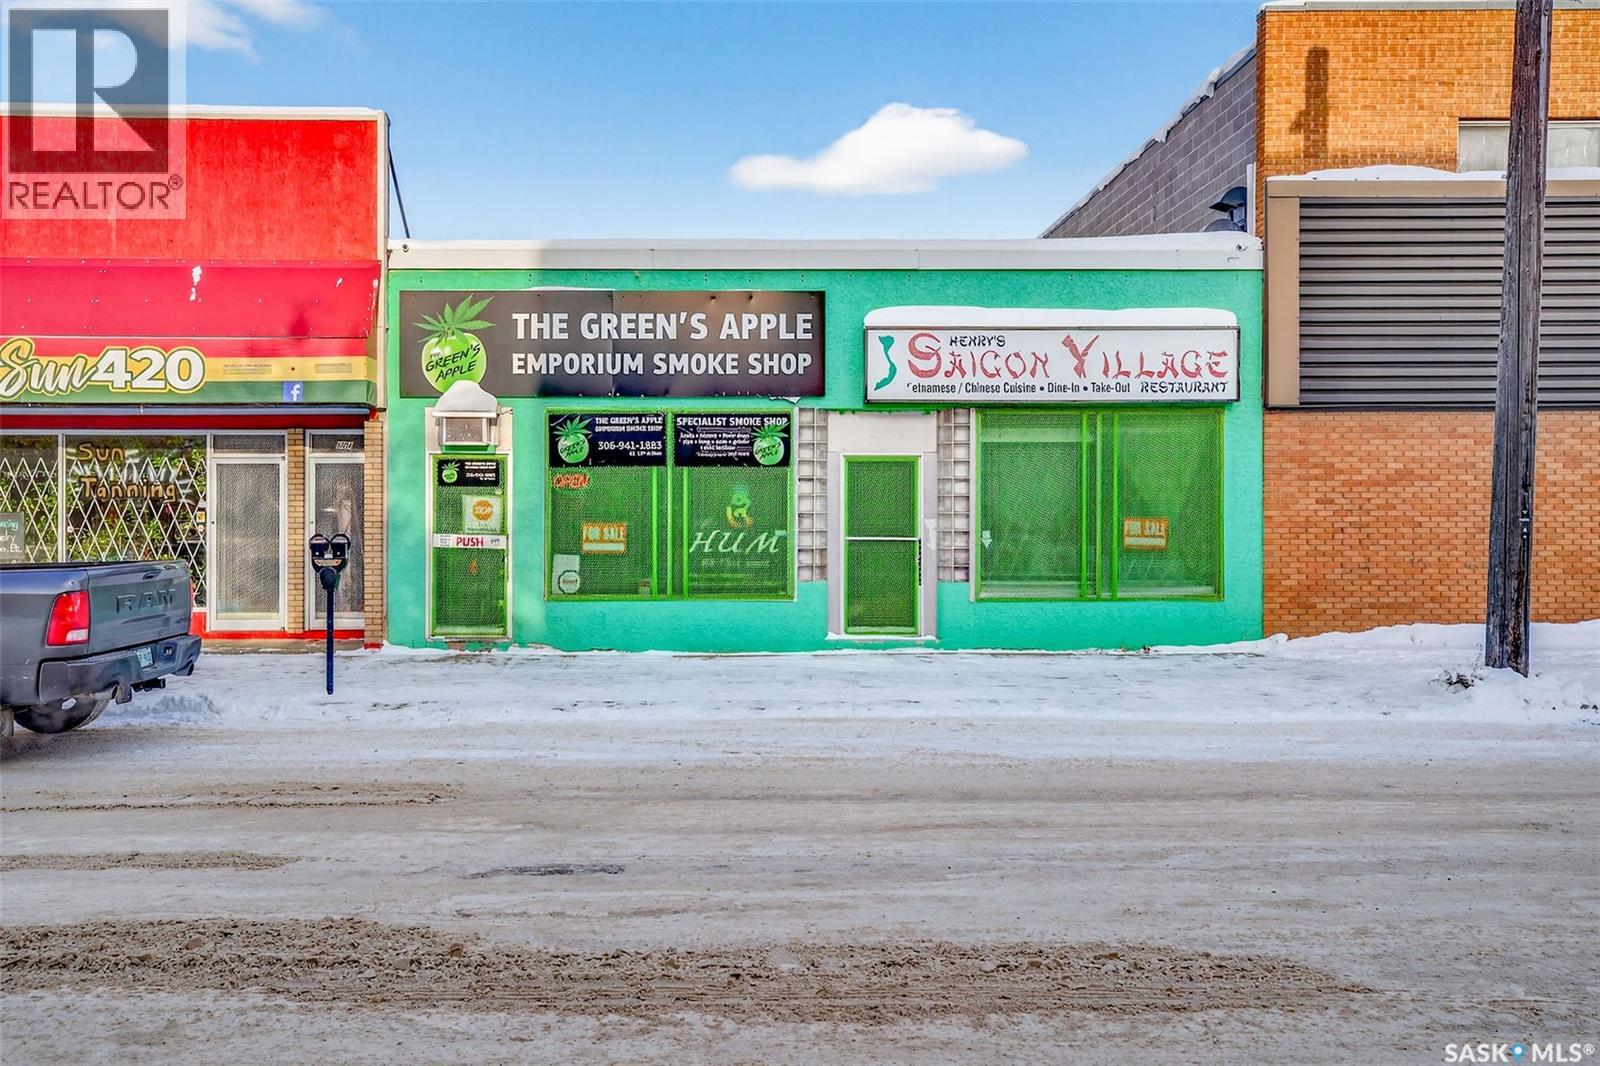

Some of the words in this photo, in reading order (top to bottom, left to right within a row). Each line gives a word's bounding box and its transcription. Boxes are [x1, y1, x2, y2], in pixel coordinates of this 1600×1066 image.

[511, 312, 569, 340] THE
[579, 312, 709, 341] GREEN'S
[719, 312, 813, 341] APPLE
[949, 334, 1006, 348] HENRY'S
[425, 343, 481, 373] GREEN'S
[511, 352, 645, 376] EMPORIUM
[653, 353, 740, 376] SMOKE
[747, 353, 813, 376] SHOP
[906, 332, 1049, 380] SAIGON
[1060, 333, 1230, 380] VILLAGE
[435, 359, 478, 384] APPLE
[964, 382, 1001, 394] Chinese
[1003, 382, 1037, 394] Cuisine
[1047, 382, 1080, 394] Dine-In
[1091, 382, 1131, 394] Take-Out
[1140, 381, 1229, 394] RESTAURANT
[676, 416, 727, 426] SPECIALIST
[729, 416, 762, 426] SMOKE
[763, 416, 789, 426] SHOP
[78, 442, 125, 462] Sun
[80, 475, 177, 503] Tanning
[456, 536, 485, 548] PUSH
